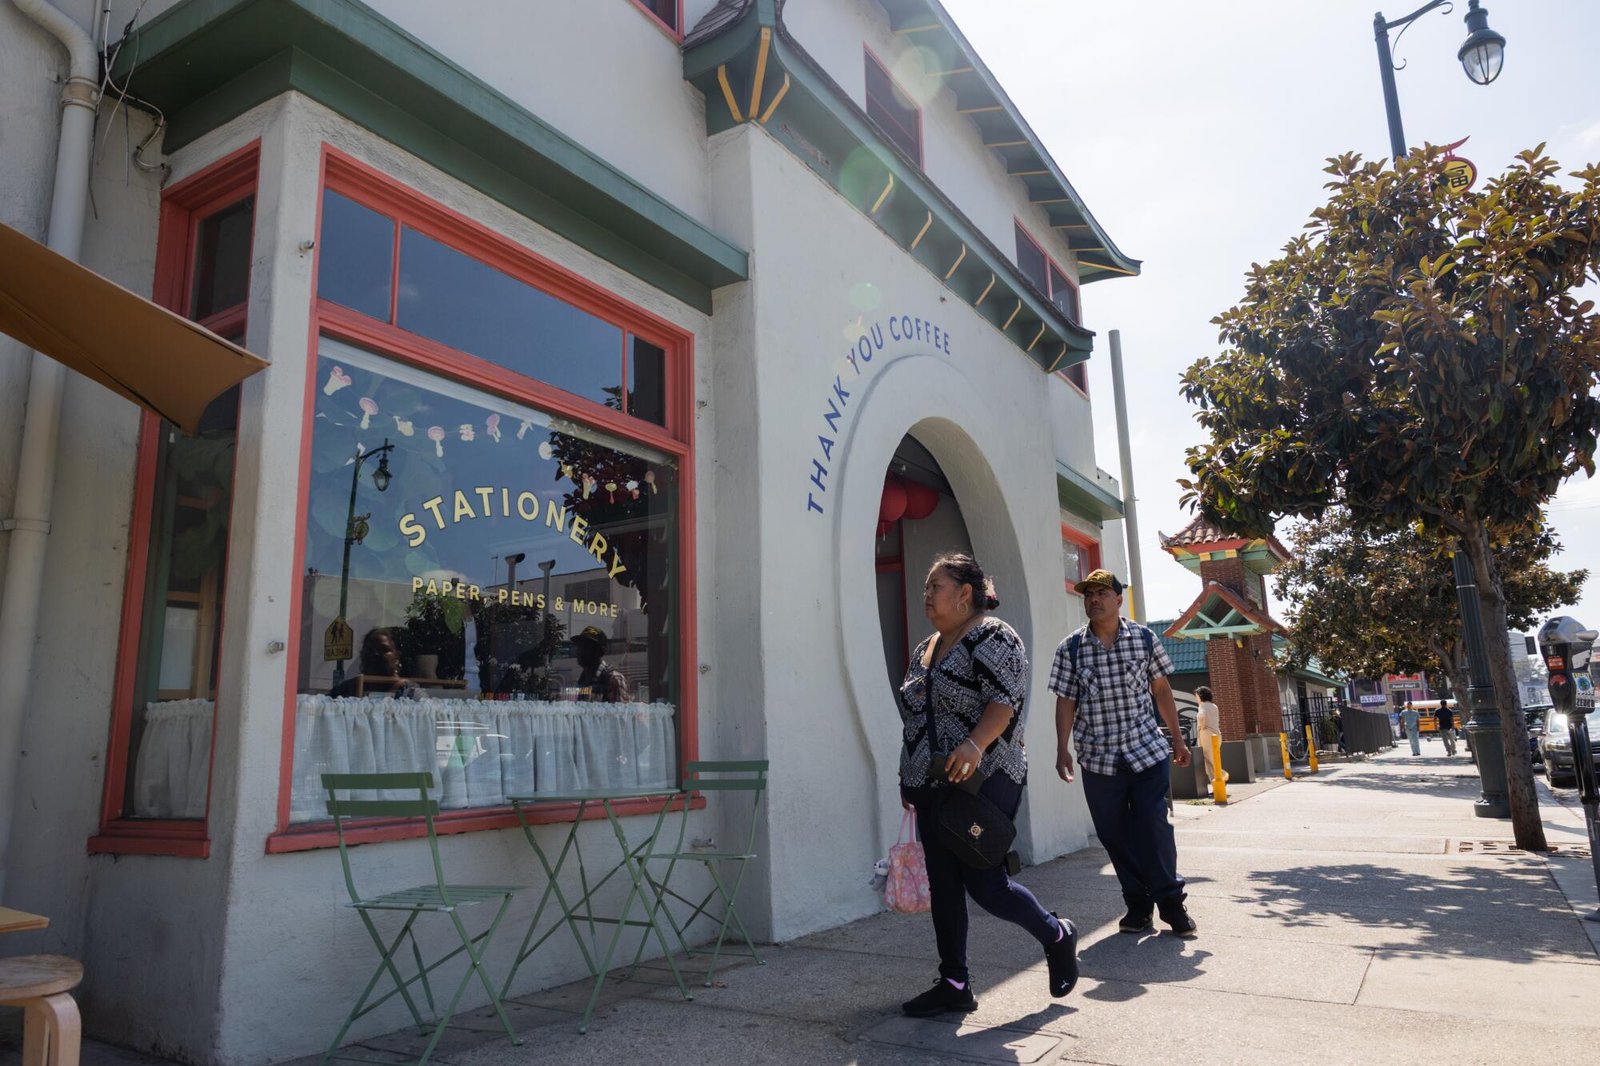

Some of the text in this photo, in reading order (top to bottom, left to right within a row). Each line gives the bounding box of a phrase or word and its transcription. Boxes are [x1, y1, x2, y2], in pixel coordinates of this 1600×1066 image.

[807, 315, 950, 515] THANK YOU COFFEE
[399, 487, 627, 580] STATIONERY
[498, 589, 546, 609] PENS
[555, 596, 565, 611] &
[573, 599, 618, 618] MORE
